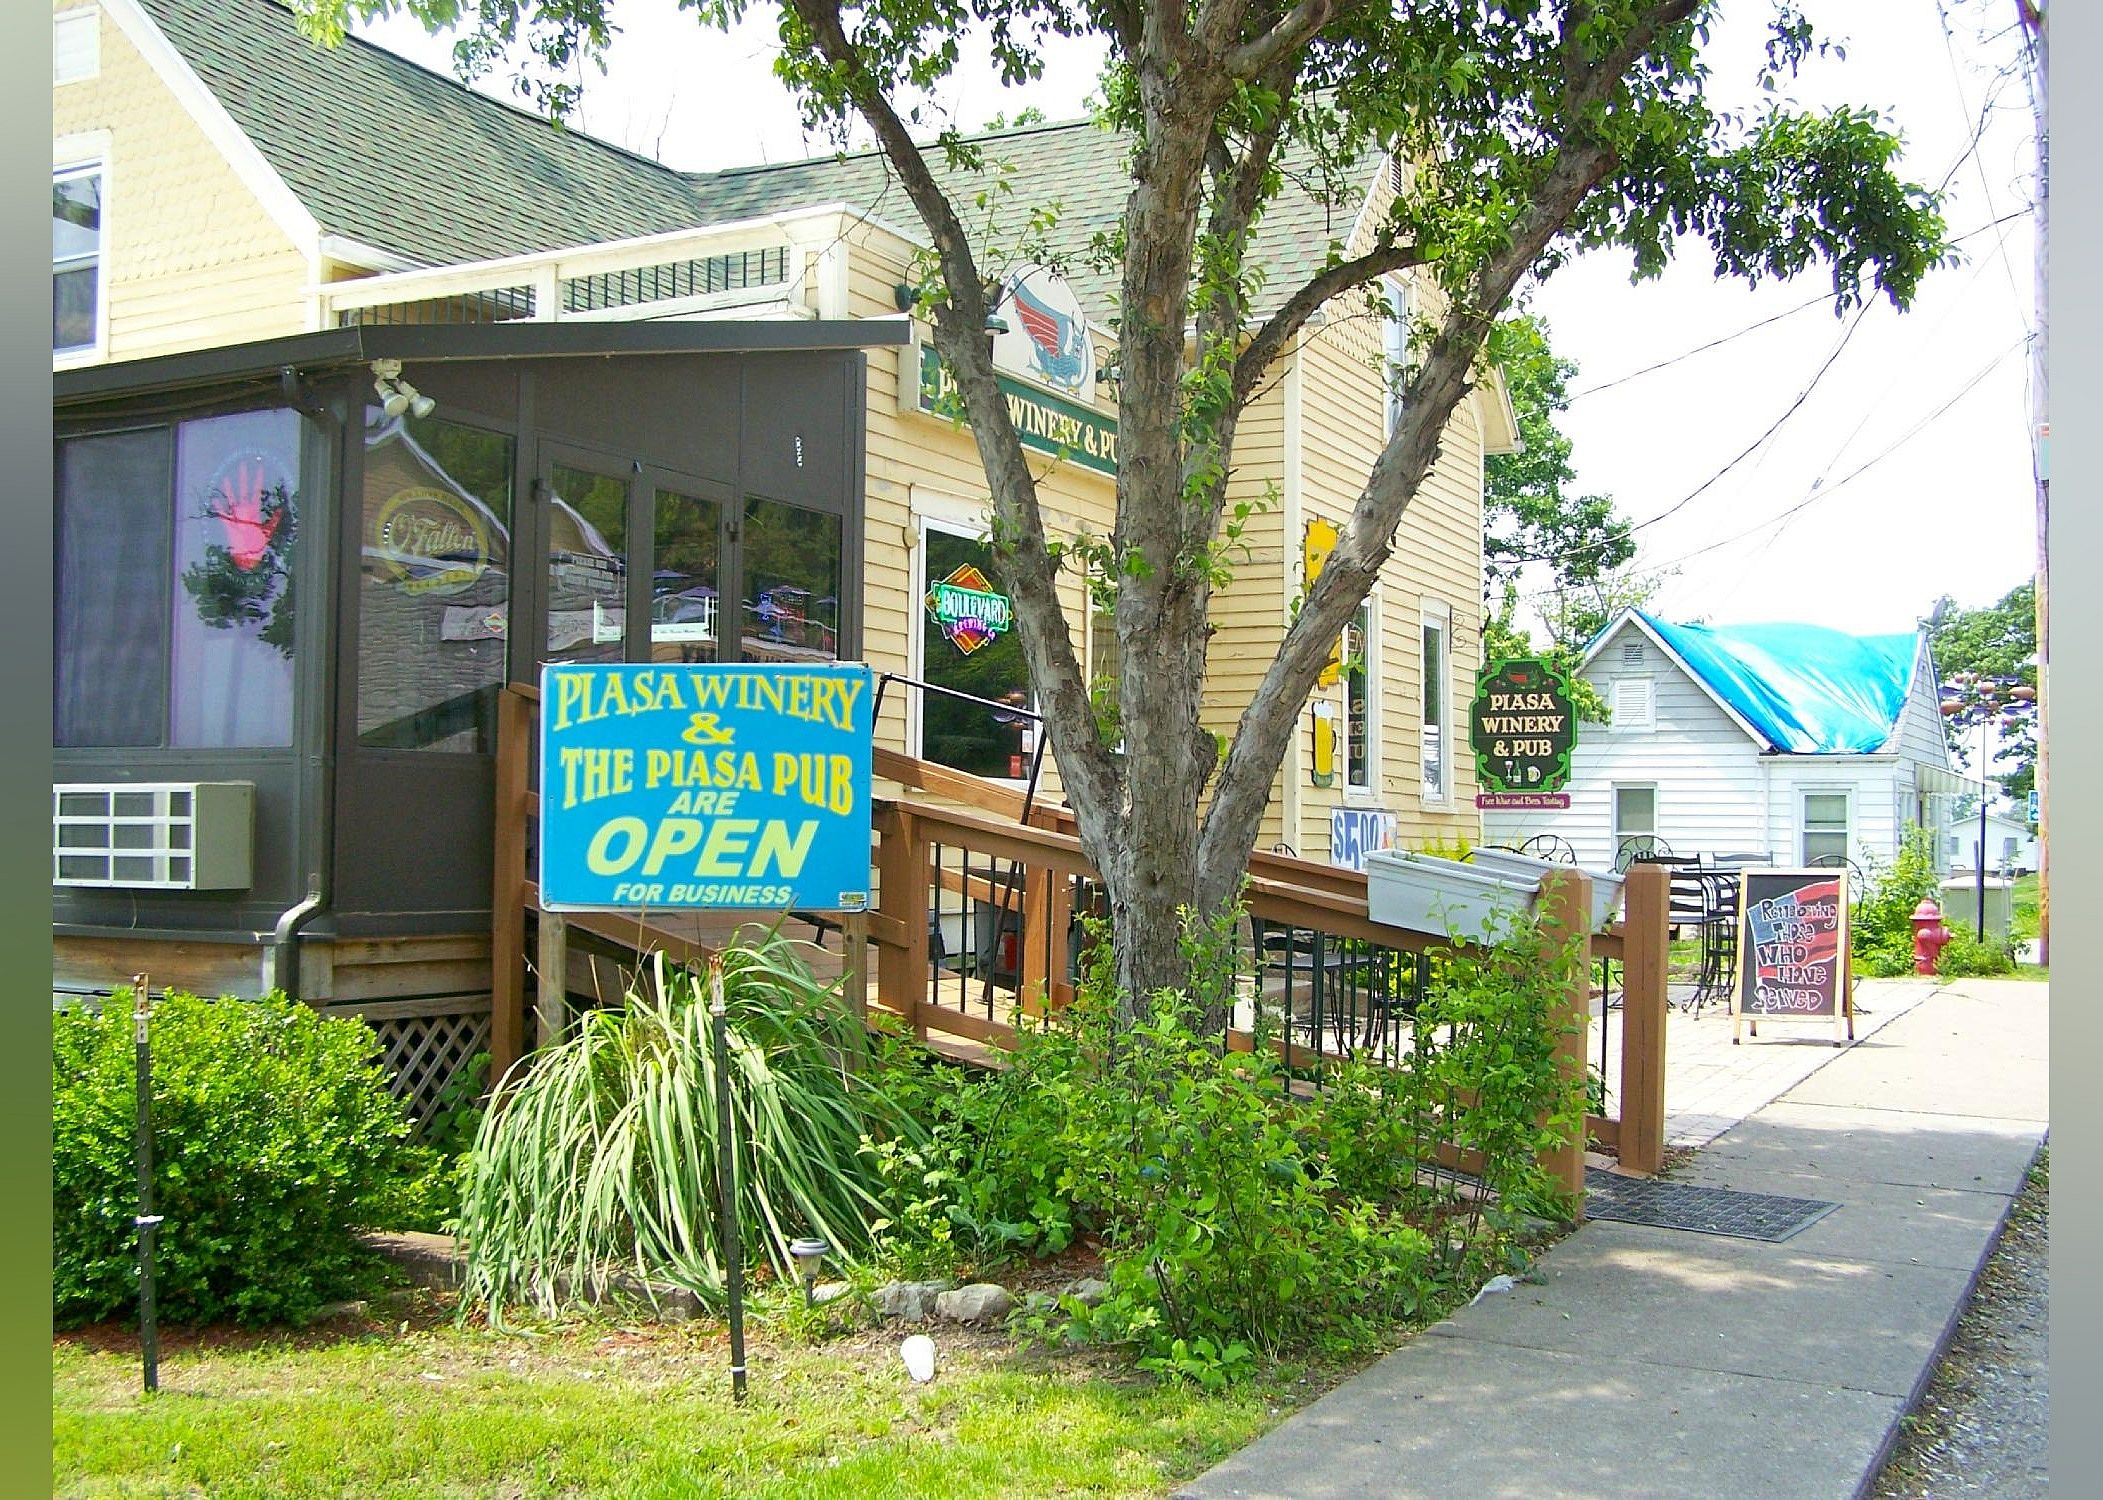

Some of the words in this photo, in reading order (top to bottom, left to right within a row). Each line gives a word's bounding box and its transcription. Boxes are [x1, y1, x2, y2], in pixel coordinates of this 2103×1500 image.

[1006, 393, 1083, 449] WINERY
[1084, 424, 1098, 456] &
[1100, 429, 1117, 463] PU
[943, 589, 1006, 625] BOULEVARD
[553, 670, 687, 732] PIASA
[690, 674, 864, 733] WINERY
[1490, 693, 1556, 711] PIASA
[682, 713, 735, 744] &
[1481, 715, 1564, 734] WINERY
[1493, 740, 1509, 757] &
[1512, 739, 1552, 757] PUB
[560, 747, 634, 810] THE
[646, 750, 763, 791] PIASA
[773, 753, 853, 816] PUB
[667, 791, 740, 815] ARE
[586, 816, 820, 878] OPEN
[613, 883, 662, 903] FOR
[668, 885, 793, 905] BUSINESS
[1756, 944, 1808, 966] WHO
